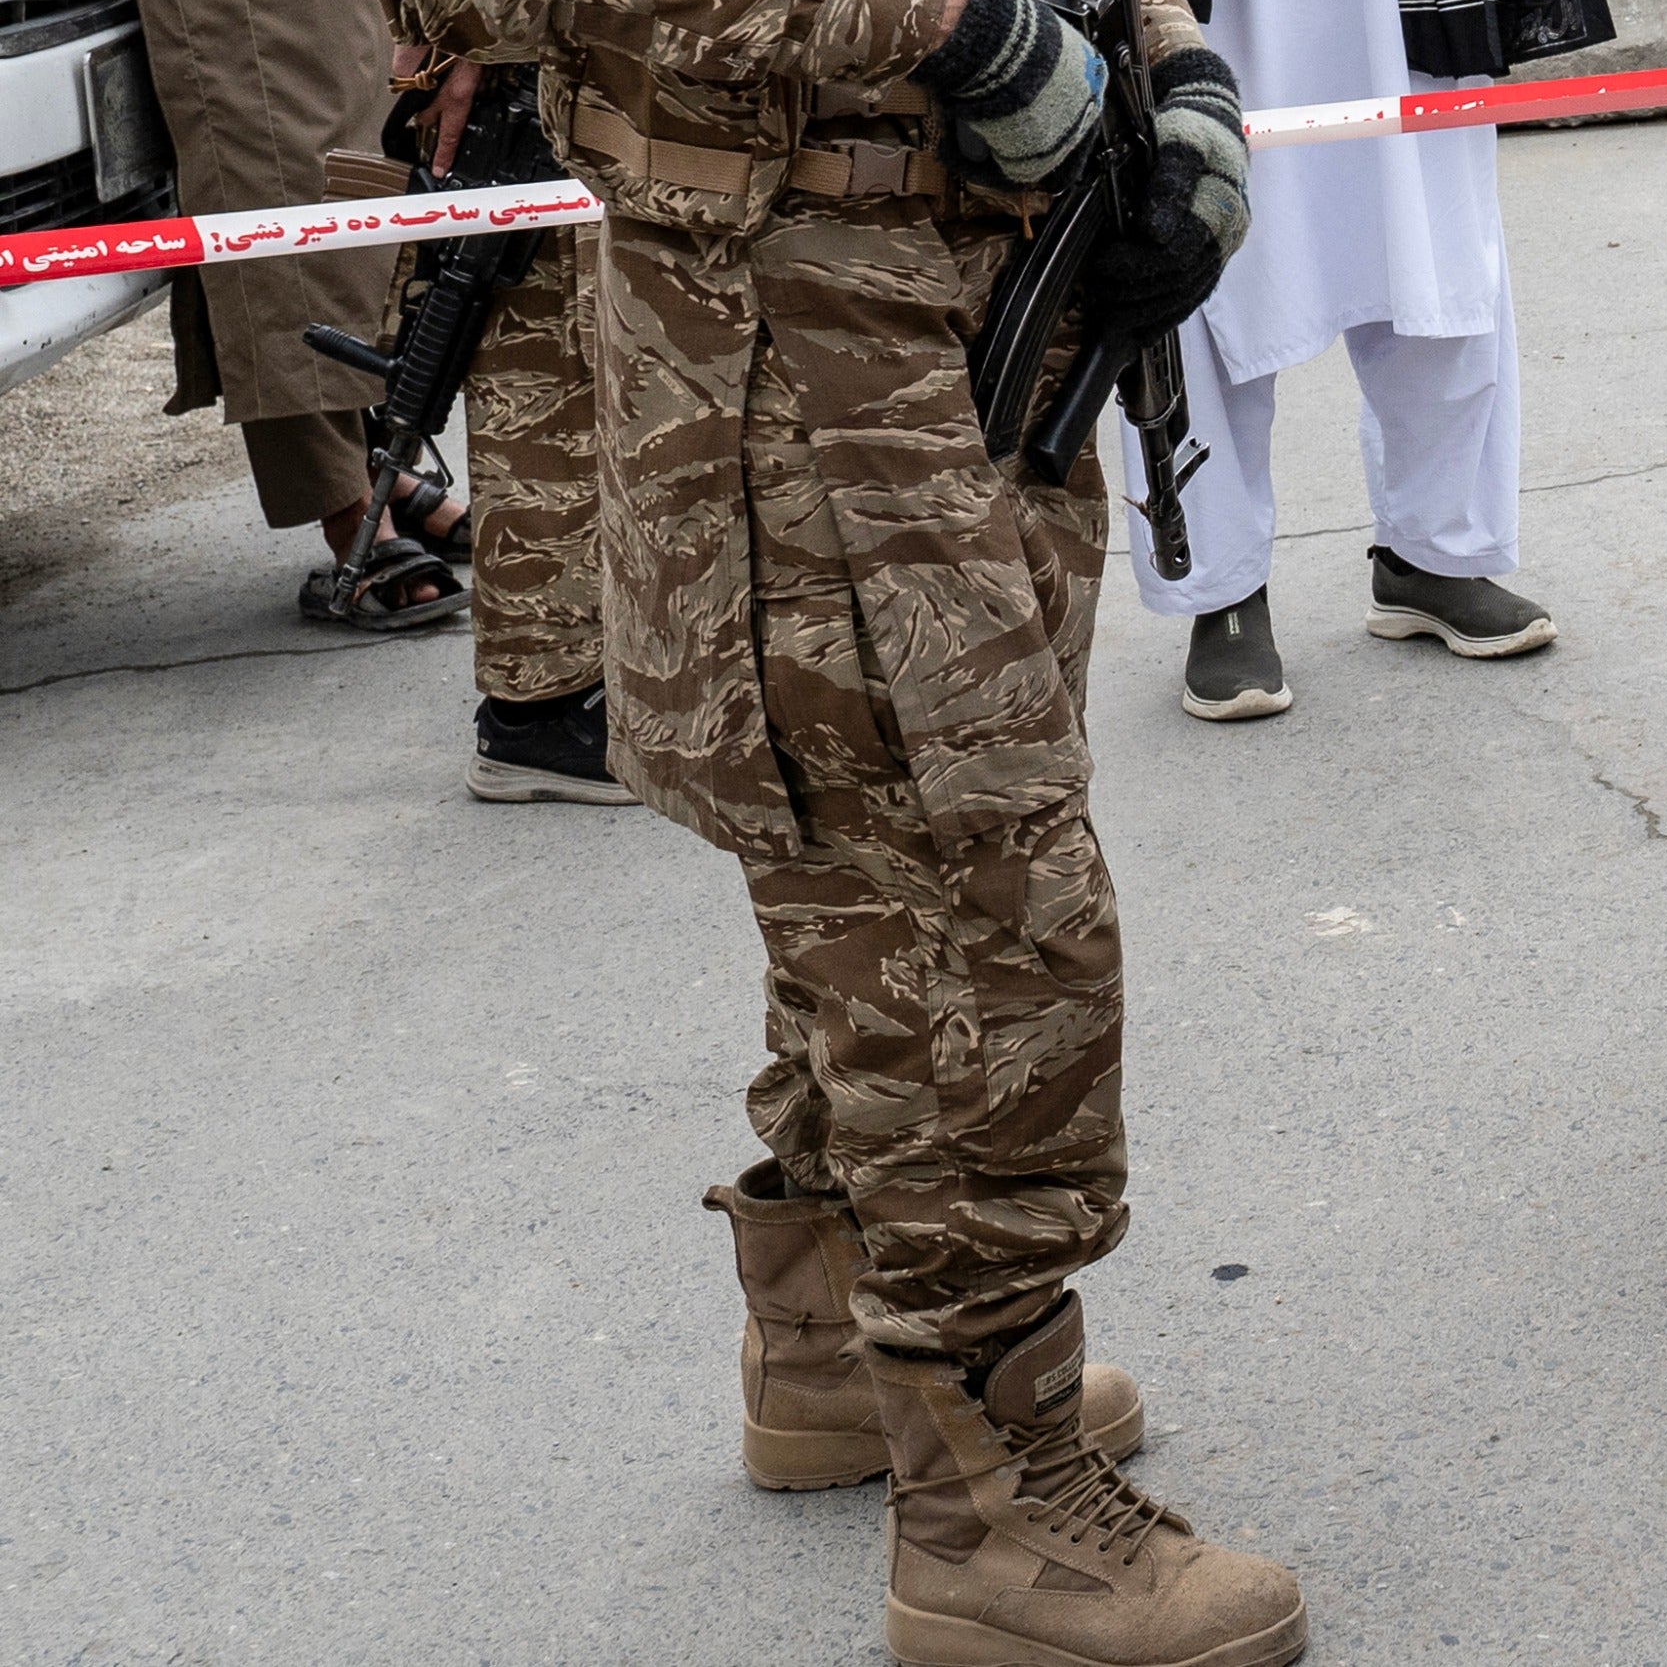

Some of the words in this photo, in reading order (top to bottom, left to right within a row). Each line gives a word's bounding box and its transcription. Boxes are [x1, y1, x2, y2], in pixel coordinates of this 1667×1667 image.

[346, 216, 381, 231] ده
[115, 233, 186, 255] ساحه
[22, 238, 108, 273] امنیتی
